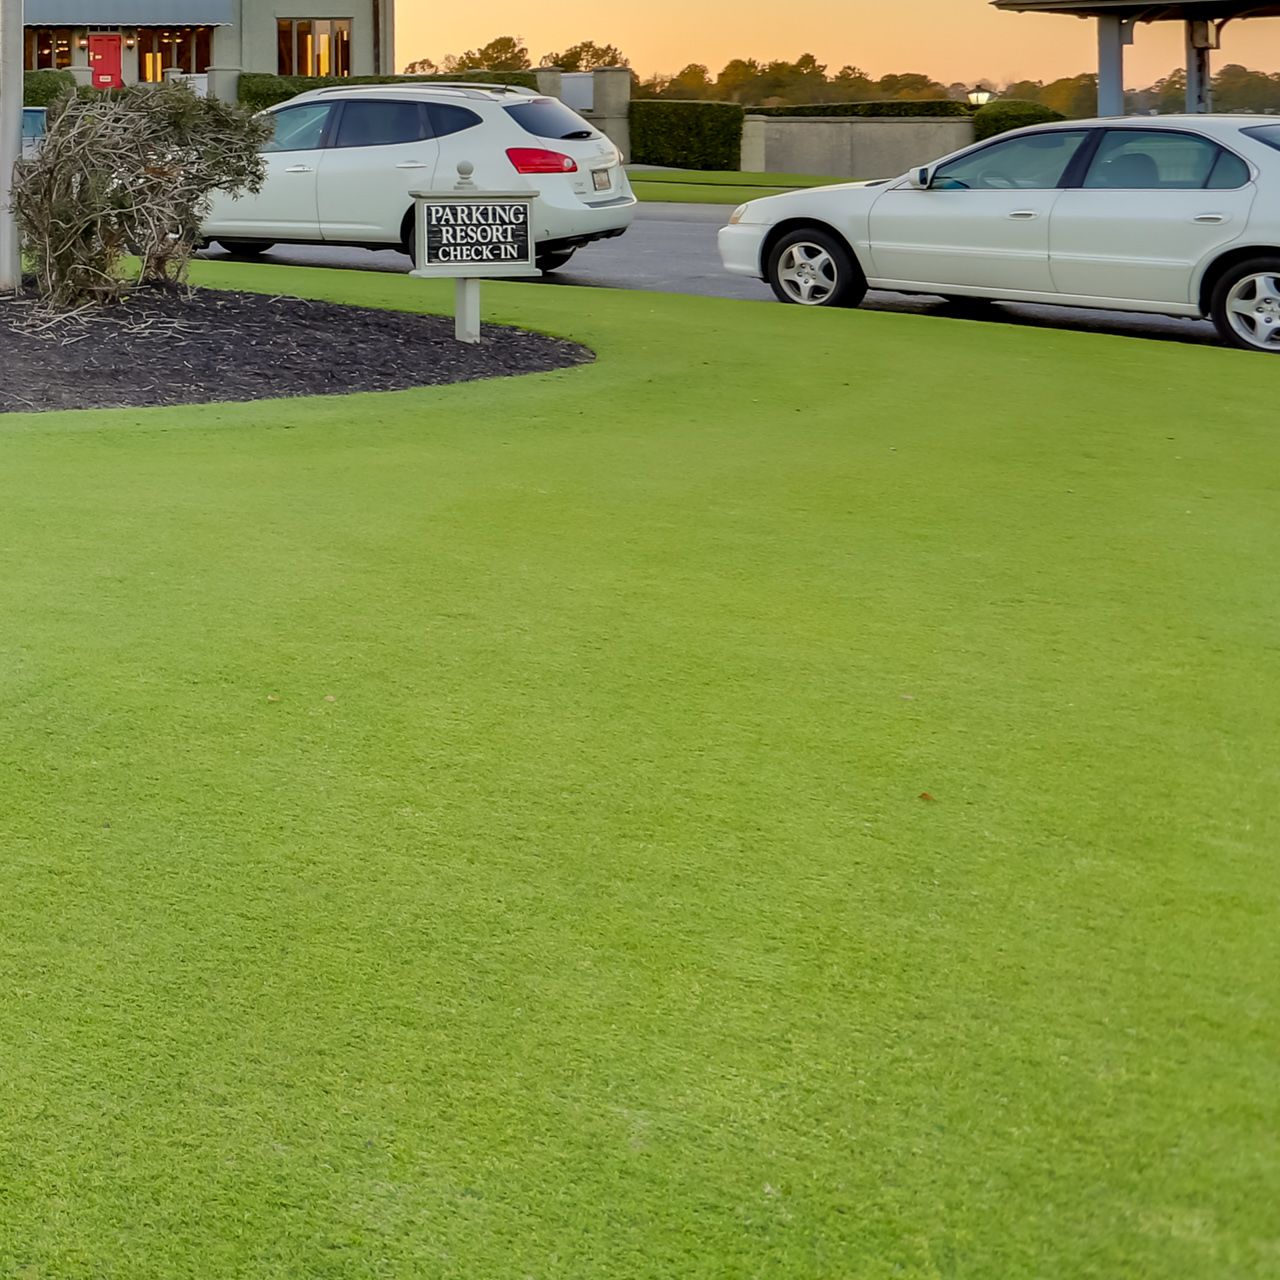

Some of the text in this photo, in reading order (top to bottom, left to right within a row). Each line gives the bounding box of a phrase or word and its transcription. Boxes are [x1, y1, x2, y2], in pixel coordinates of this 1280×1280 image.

[429, 205, 525, 225] PARKING
[440, 224, 516, 244] RESORT
[438, 244, 518, 261] CHECK-IN
